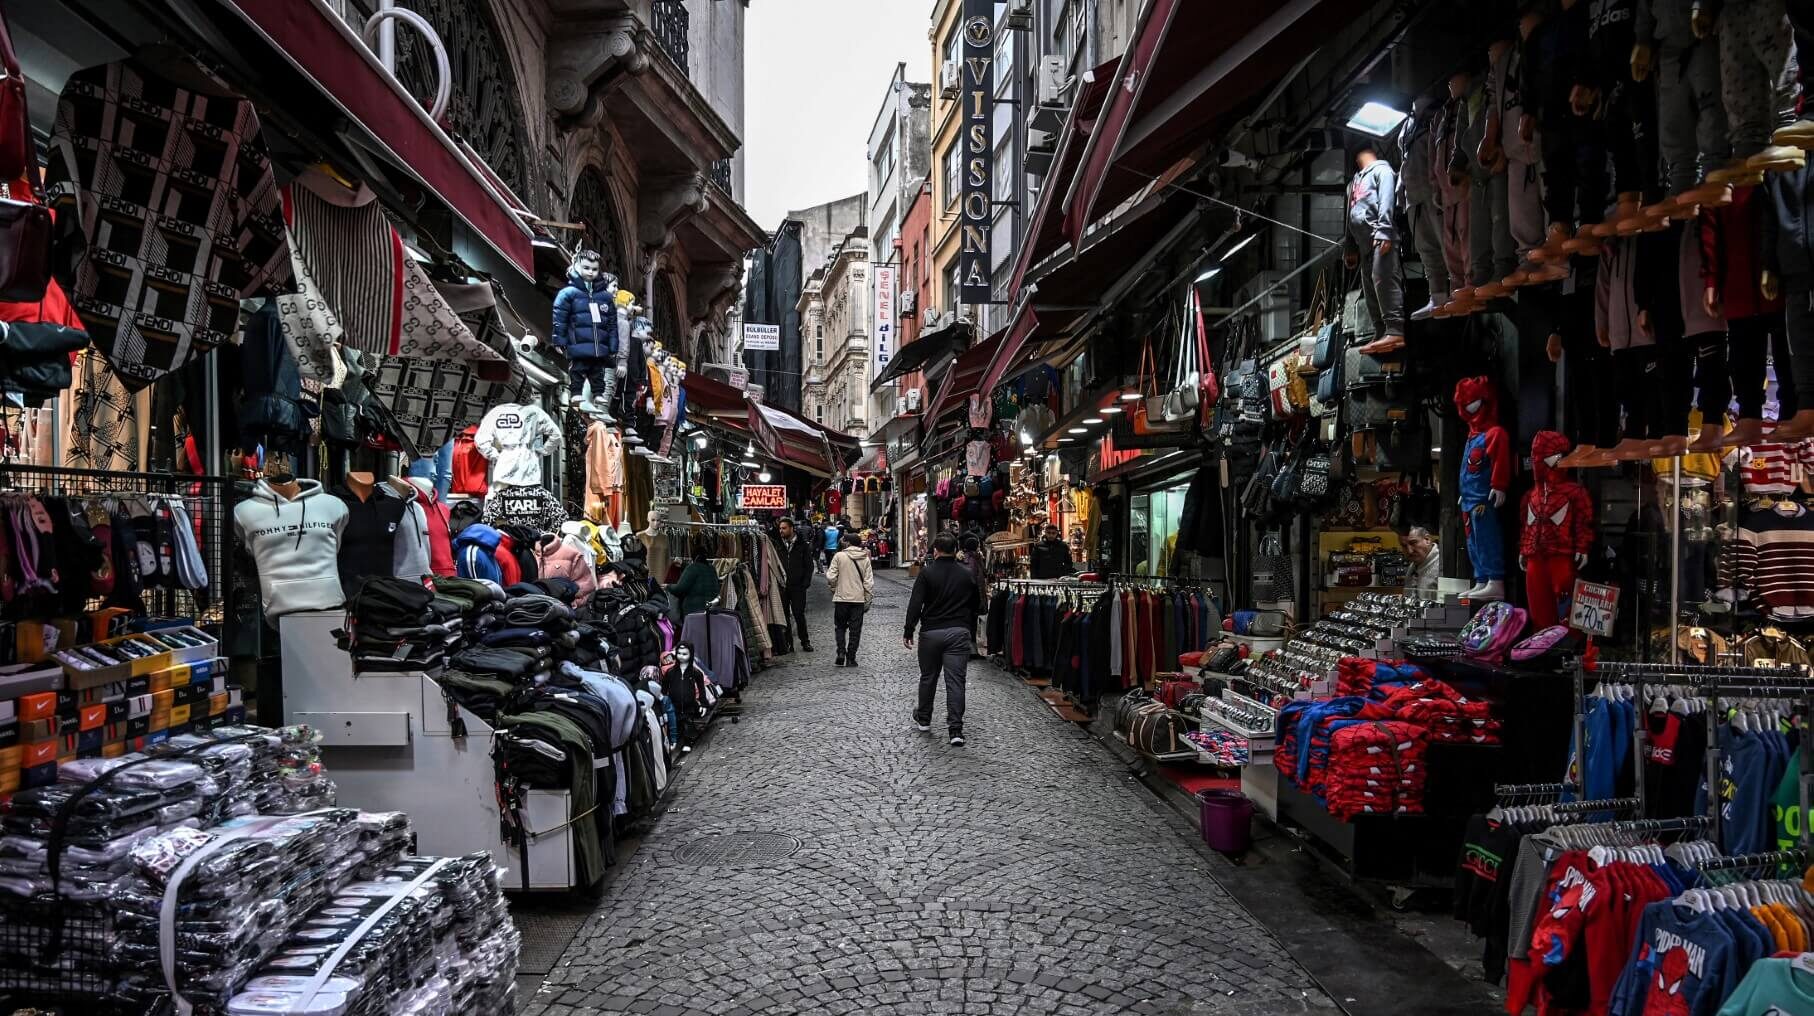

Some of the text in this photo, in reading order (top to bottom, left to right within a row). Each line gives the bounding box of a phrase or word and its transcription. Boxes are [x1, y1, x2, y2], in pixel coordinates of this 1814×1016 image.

[964, 57, 991, 286] VISSONA
[102, 198, 138, 217] FENDI
[158, 216, 194, 236] FENDI
[146, 266, 183, 284] FENDI
[135, 312, 173, 331] FENDI
[120, 362, 156, 381] FENDI
[743, 497, 783, 505] CAMLAR
[746, 488, 781, 496] HAYALET
[504, 499, 541, 511] KARL
[256, 526, 285, 536] TOMMY
[1584, 605, 1597, 629] 70
